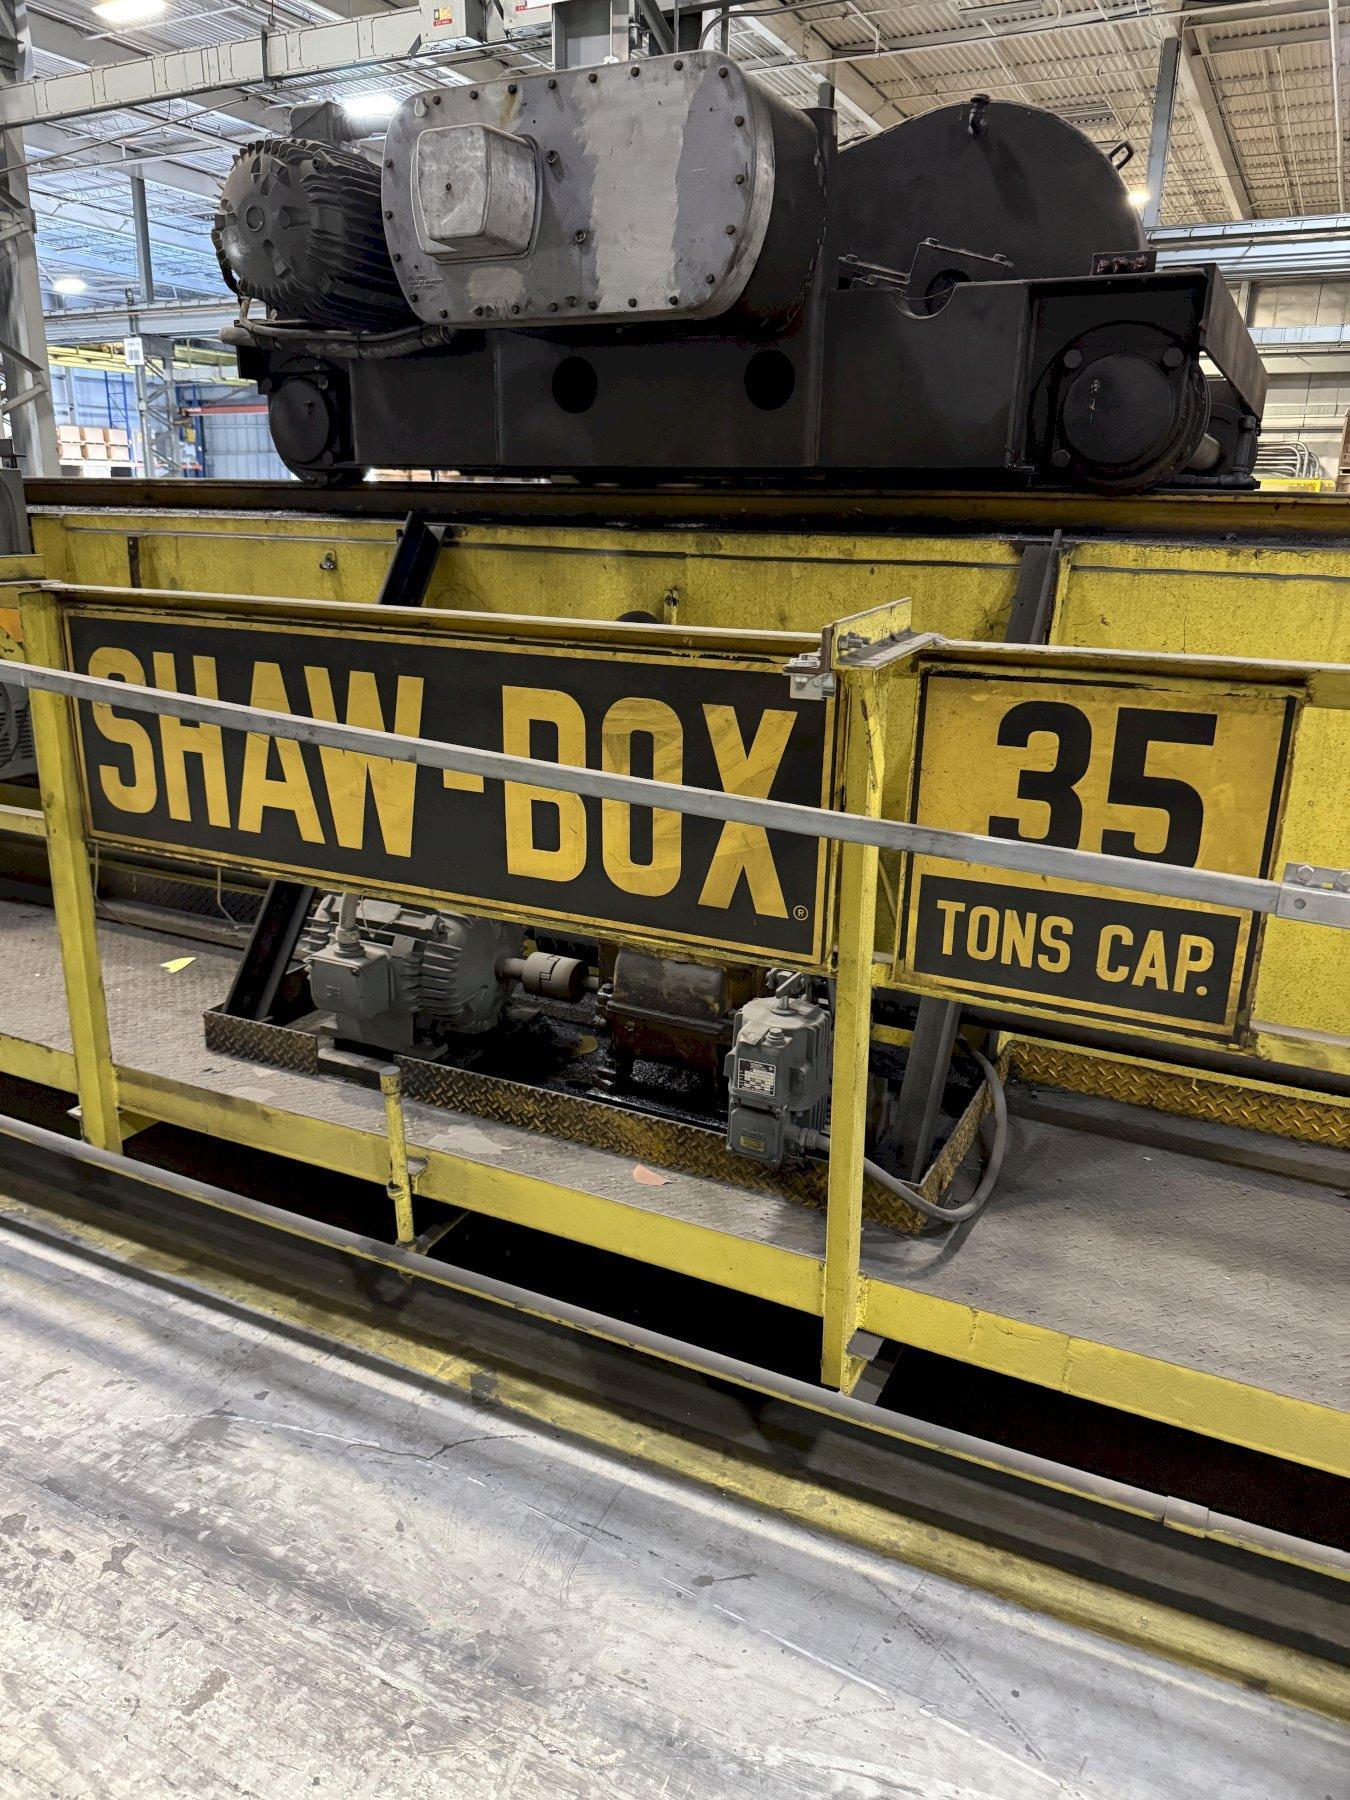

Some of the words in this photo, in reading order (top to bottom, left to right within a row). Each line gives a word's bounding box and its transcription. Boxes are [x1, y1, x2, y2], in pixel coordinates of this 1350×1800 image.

[988, 700, 1218, 868] 35
[937, 900, 1073, 973] TONS
[1096, 924, 1214, 996] CAP.
